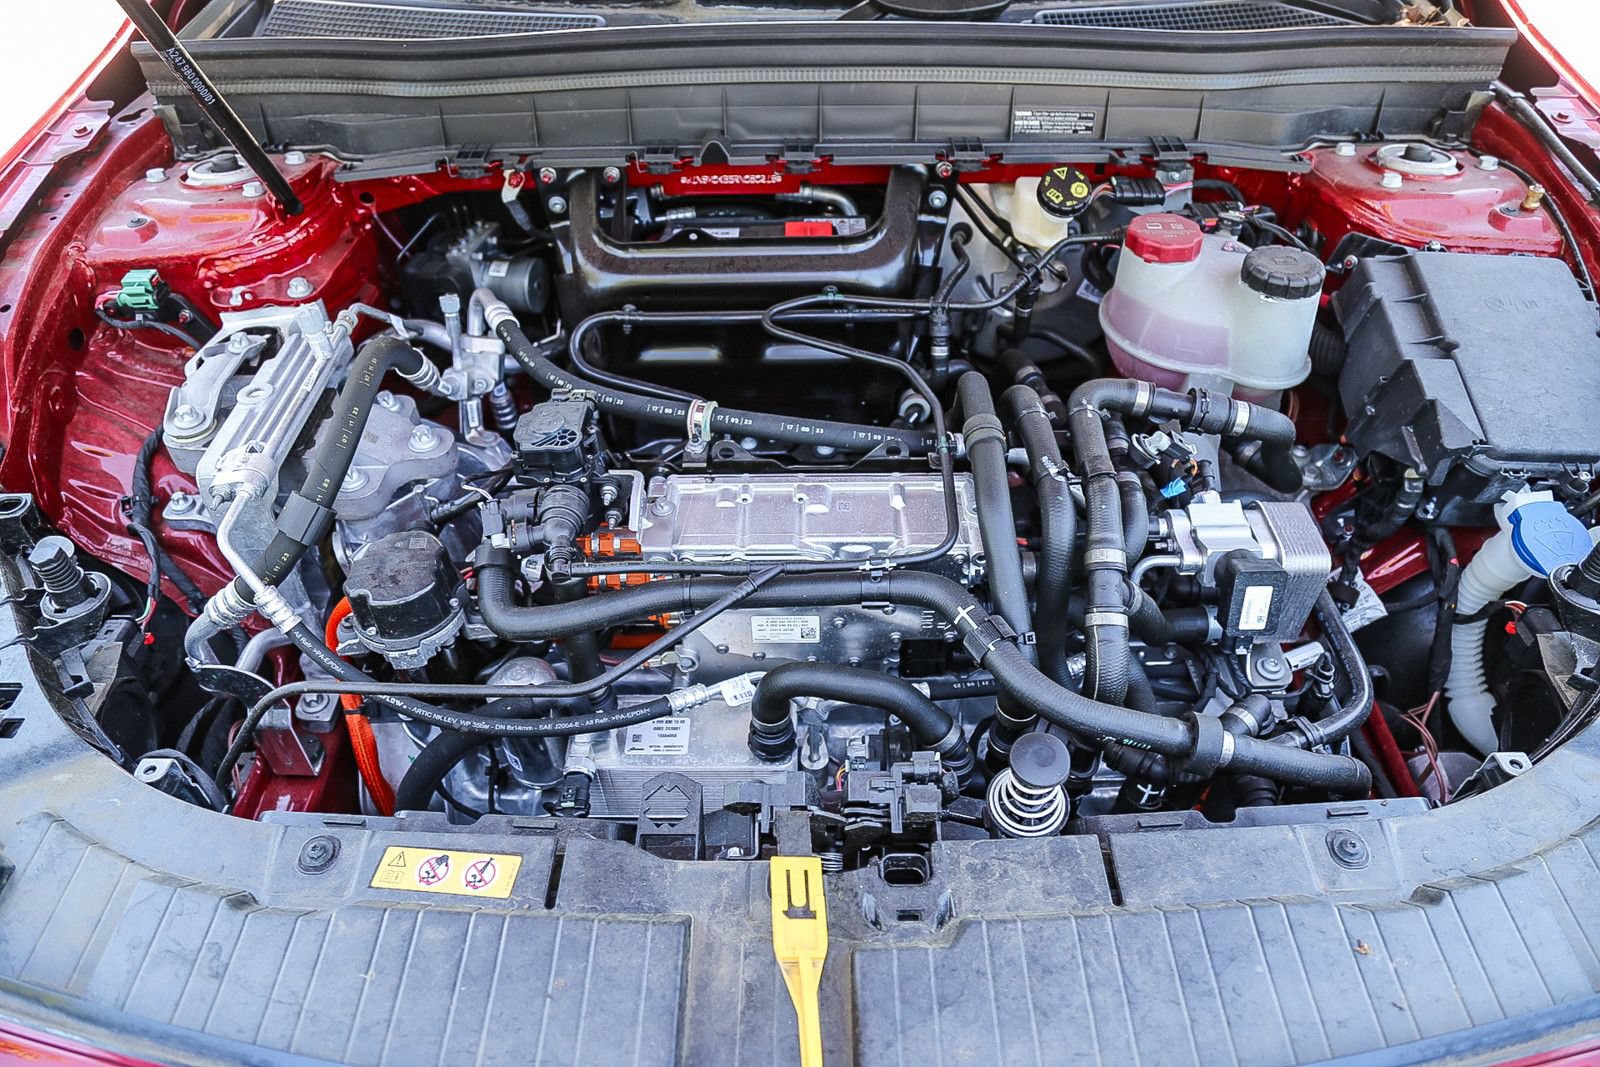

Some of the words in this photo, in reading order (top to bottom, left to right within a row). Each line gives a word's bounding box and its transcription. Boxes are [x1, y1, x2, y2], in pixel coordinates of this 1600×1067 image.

[166, 47, 186, 66] A247
[181, 64, 196, 80] 980
[538, 723, 553, 731] SAE
